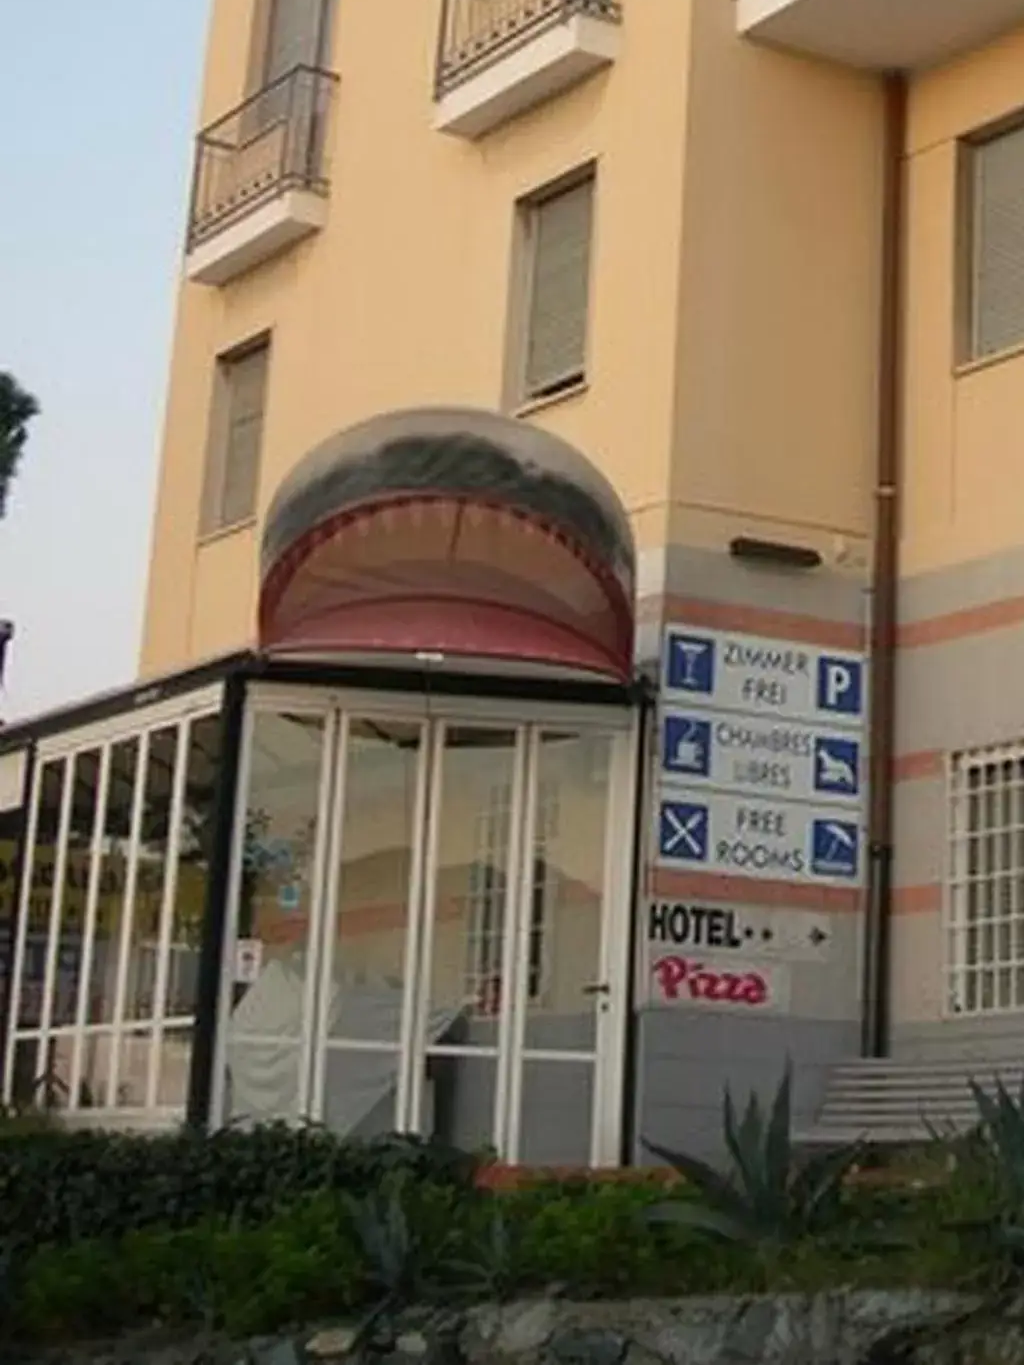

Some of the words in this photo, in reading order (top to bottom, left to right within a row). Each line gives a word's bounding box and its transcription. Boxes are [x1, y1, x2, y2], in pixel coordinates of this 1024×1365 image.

[723, 643, 809, 677] ZIMMER
[741, 677, 788, 706] FREI
[826, 666, 851, 705] P
[716, 721, 811, 757] CHAMBRES
[732, 760, 791, 789] LIBRES
[736, 807, 785, 837] FREE
[716, 840, 804, 872] ROOMS
[649, 903, 743, 947] HOTEL
[654, 955, 769, 1005] Pizza
